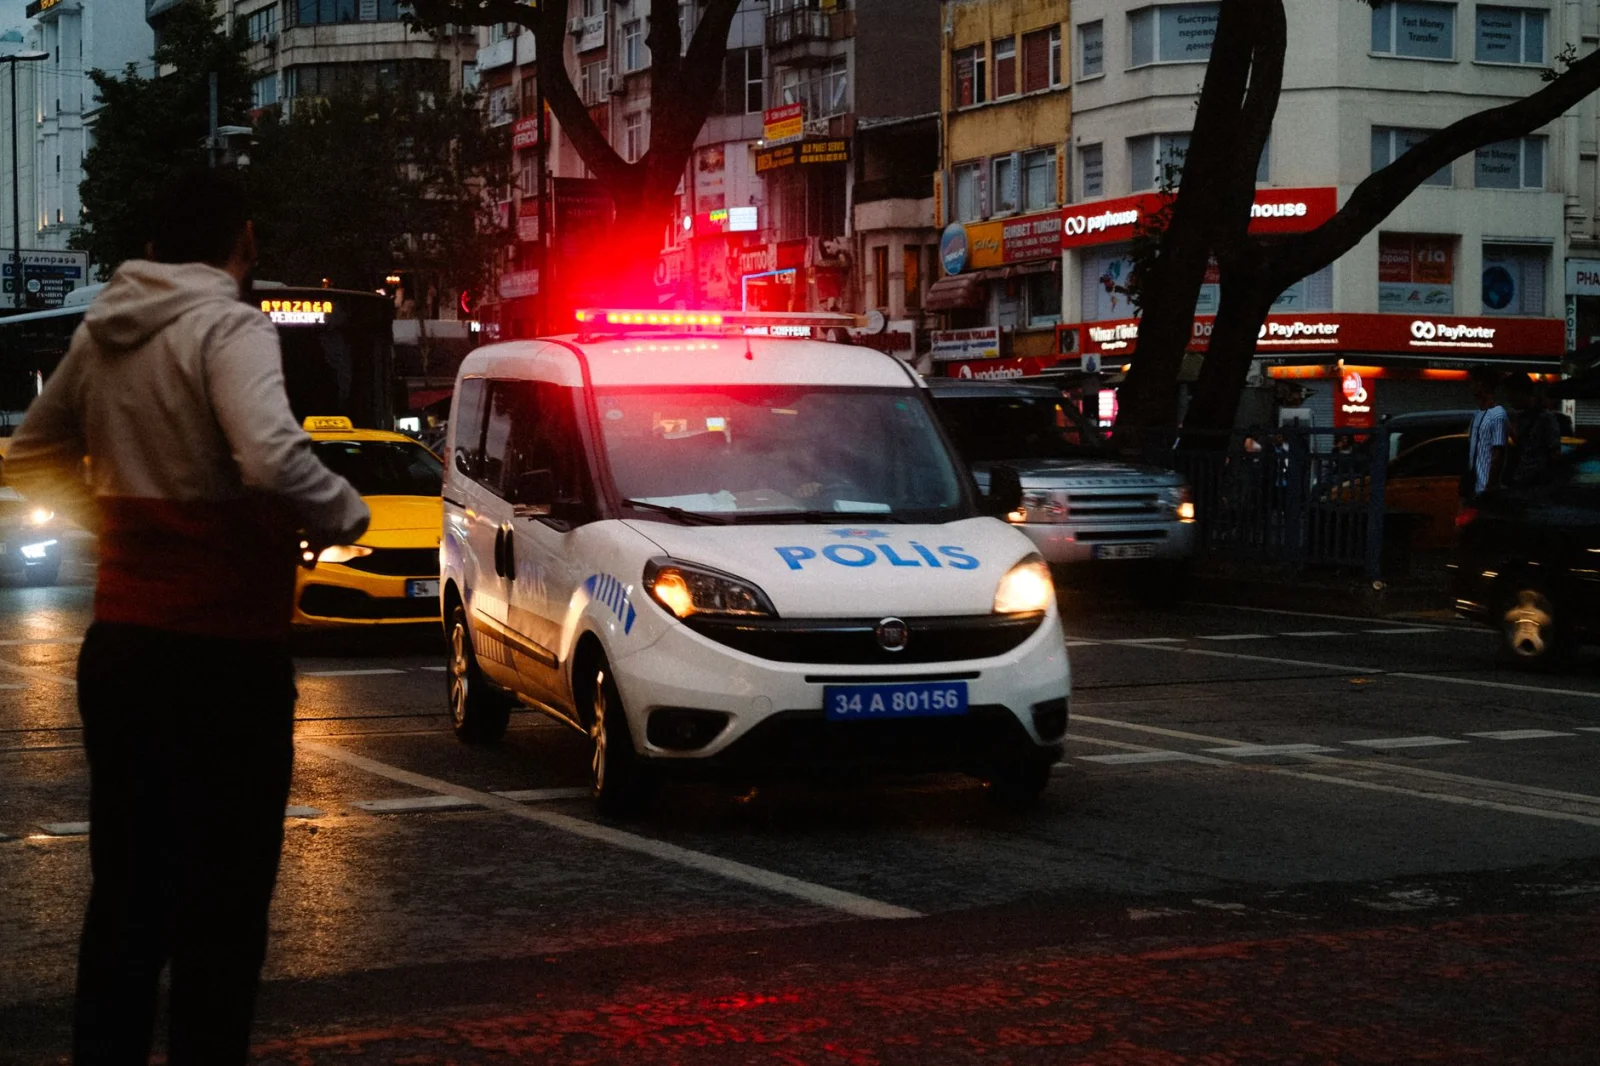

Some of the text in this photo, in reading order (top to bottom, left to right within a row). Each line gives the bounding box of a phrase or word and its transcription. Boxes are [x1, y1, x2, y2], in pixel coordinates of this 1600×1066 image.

[1419, 18, 1445, 30] Money
[1179, 29, 1217, 39] перево
[1408, 32, 1439, 43] Transfer
[1250, 203, 1307, 218] house
[1087, 210, 1138, 233] payhouse
[8, 253, 77, 265] Byrampaşa
[261, 300, 333, 313] AYAZAĞA
[1268, 322, 1340, 338] PayPorter
[1437, 324, 1496, 340] PayPorter
[974, 365, 1024, 380] vodafone
[773, 540, 981, 570] POLİS
[835, 689, 958, 714] 34 A 80156
